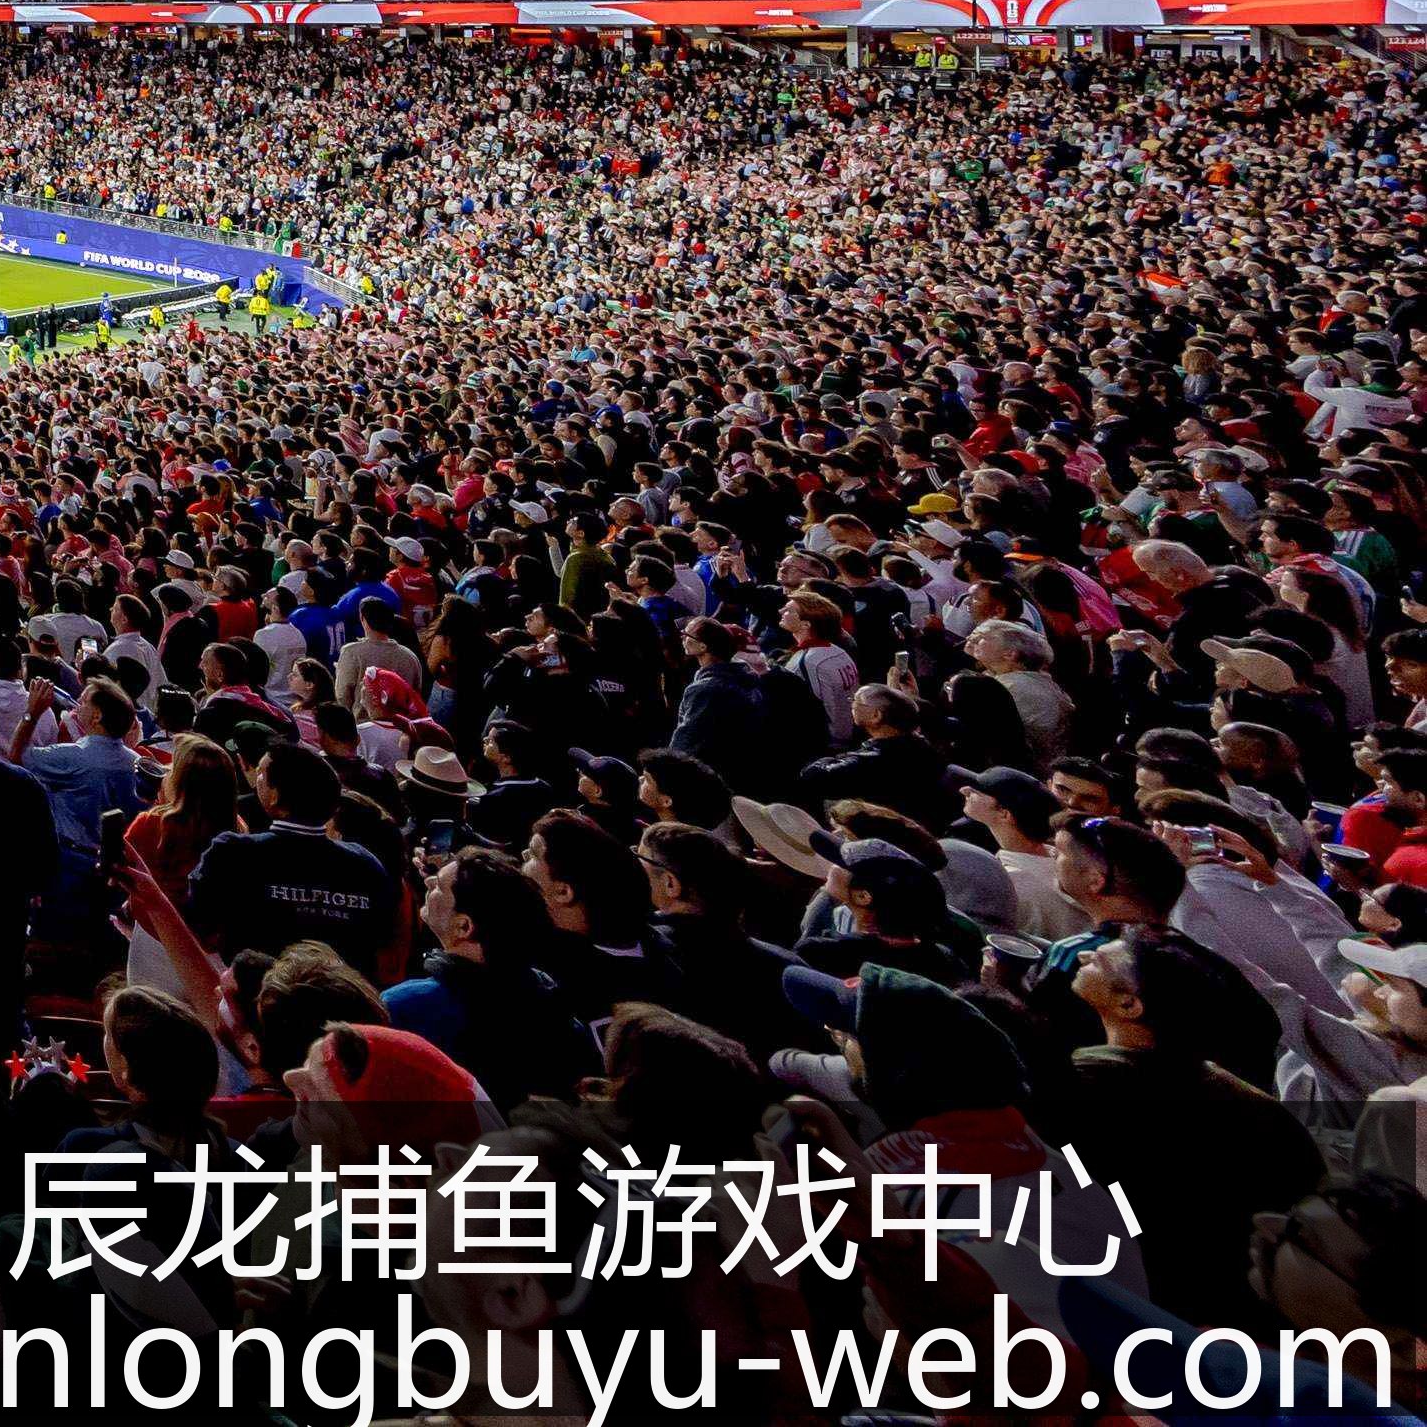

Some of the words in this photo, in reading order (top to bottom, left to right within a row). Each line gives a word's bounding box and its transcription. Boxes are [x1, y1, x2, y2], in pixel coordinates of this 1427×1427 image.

[83, 251, 110, 265] FIFA
[110, 255, 155, 271] WORLD
[156, 263, 182, 276] CUP
[182, 268, 220, 283] 2026
[270, 885, 370, 909] HILFIGER
